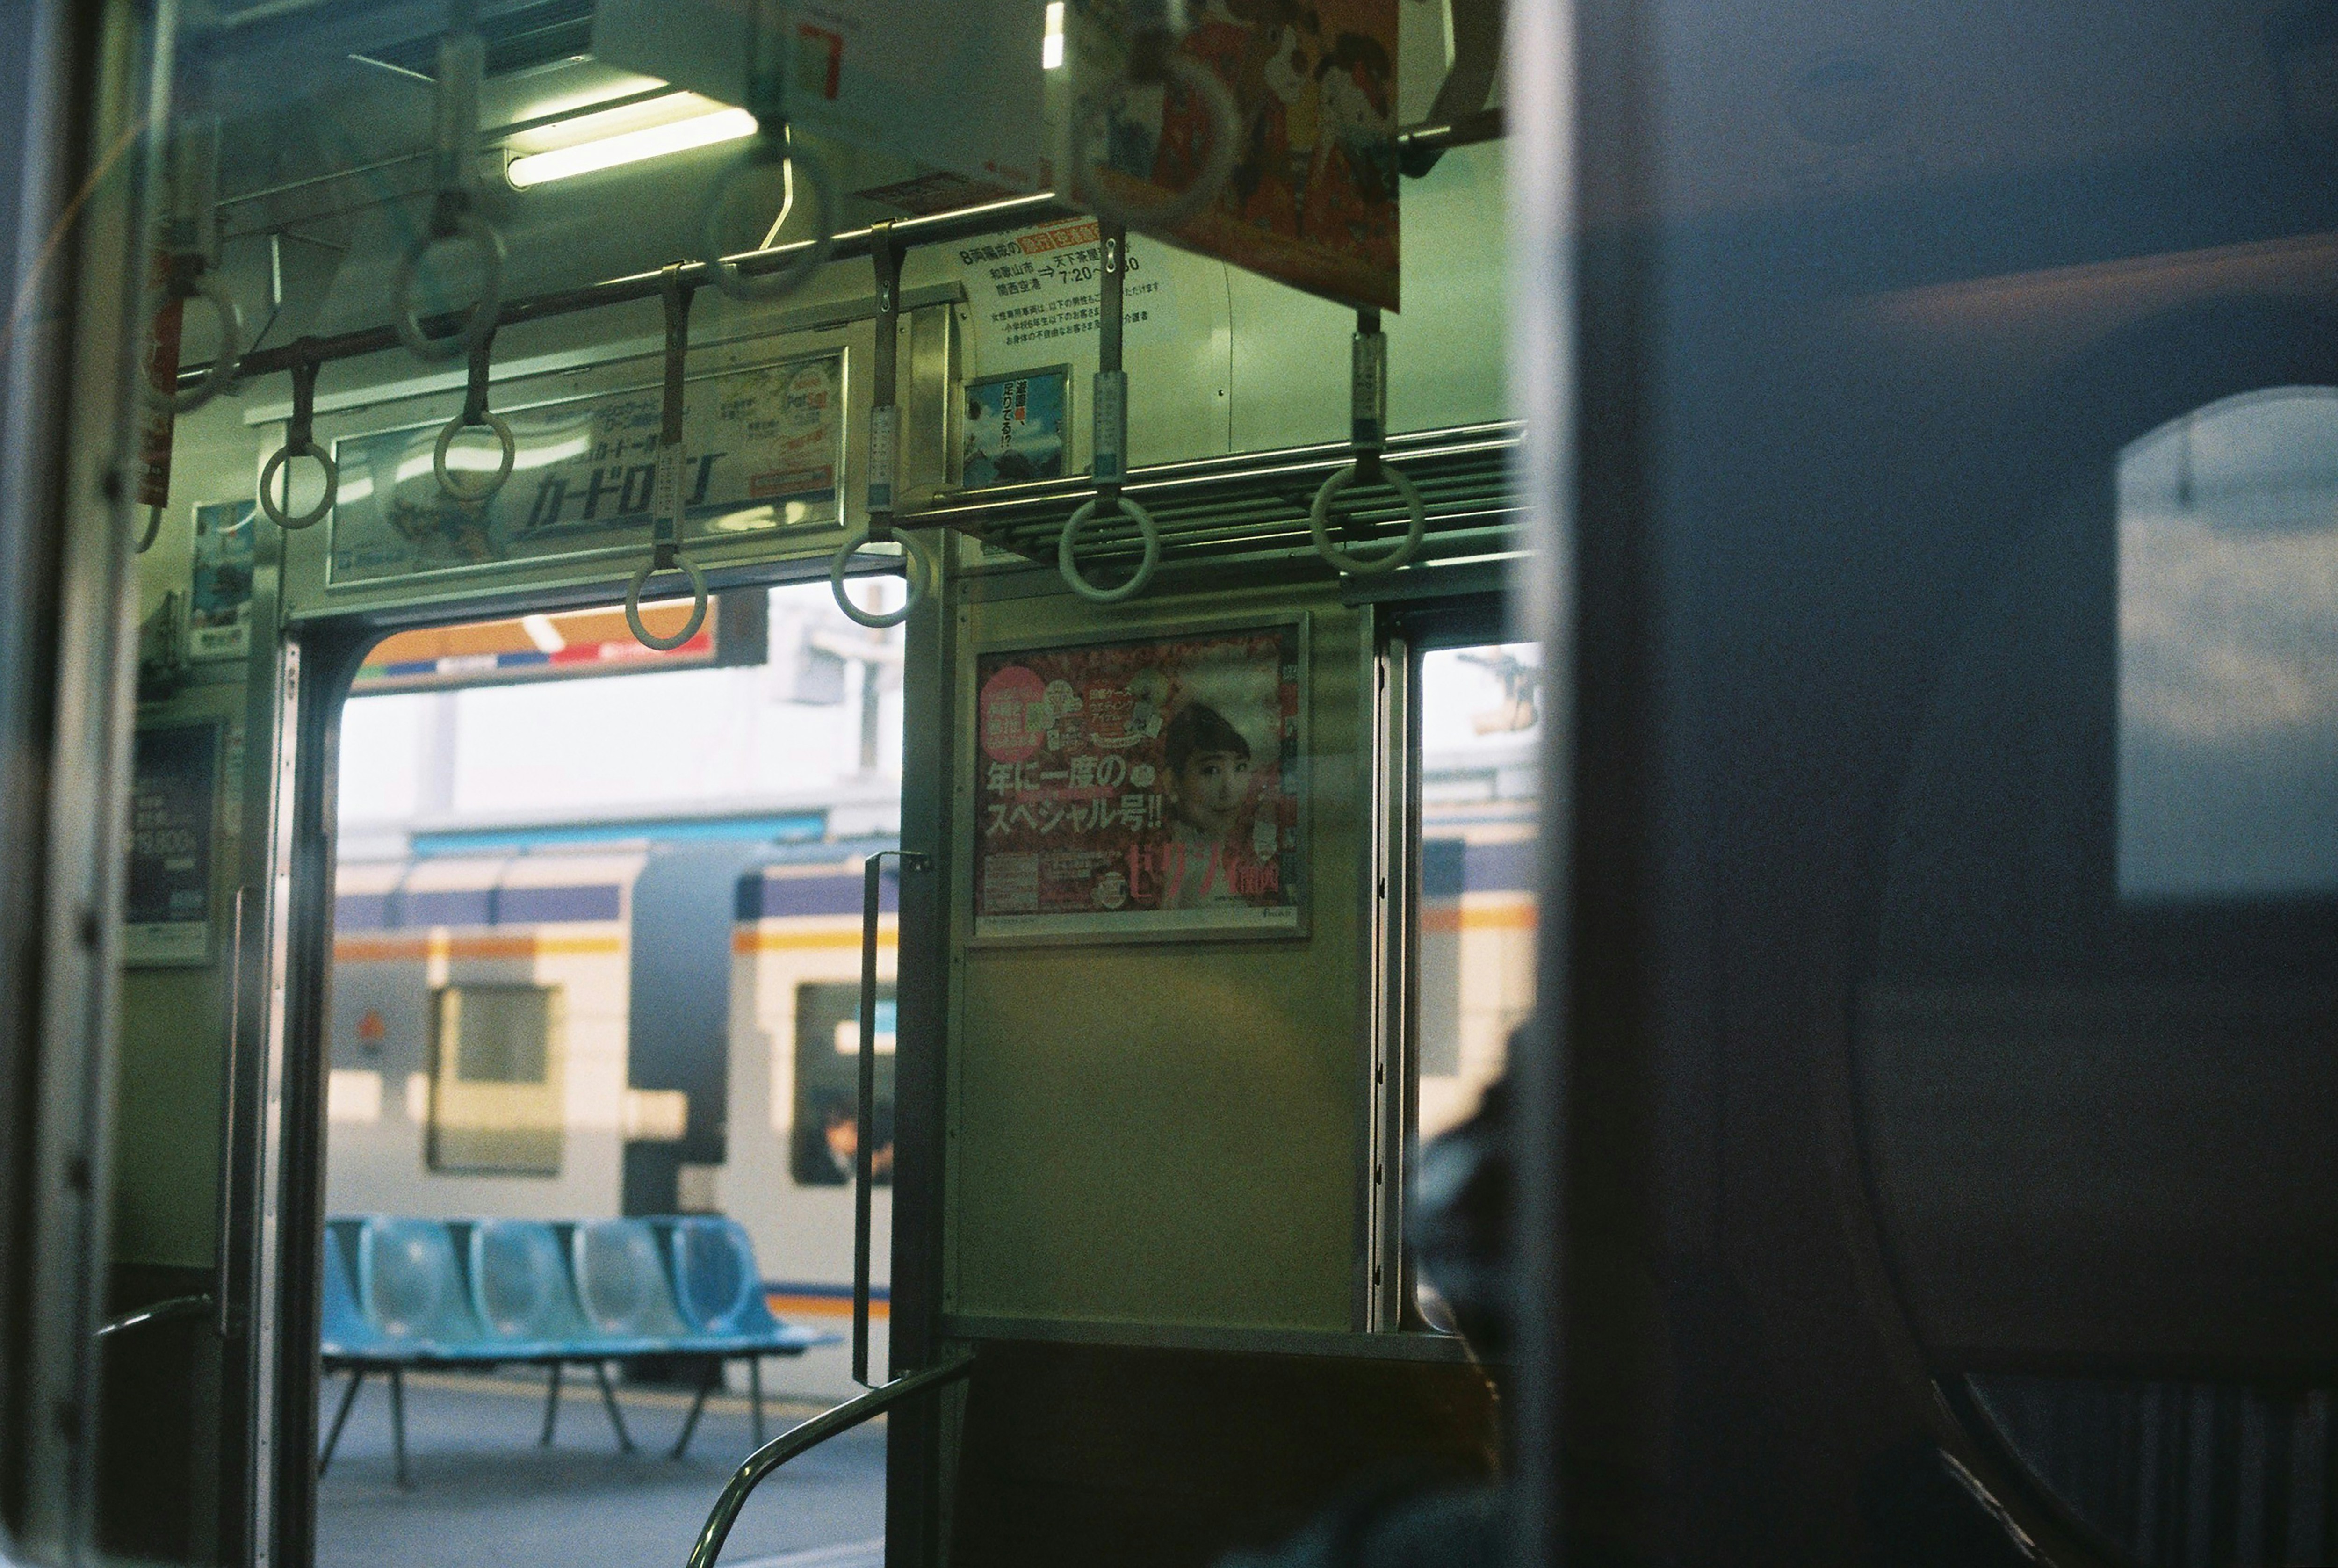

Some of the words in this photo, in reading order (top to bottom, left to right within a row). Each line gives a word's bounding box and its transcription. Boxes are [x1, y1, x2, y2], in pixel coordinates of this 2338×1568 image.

[990, 262, 1033, 280] 和歌山市
[996, 278, 1041, 297] 関西空港
[986, 753, 1126, 795] 年に一度の
[985, 793, 1162, 836] スペシャル号!!
